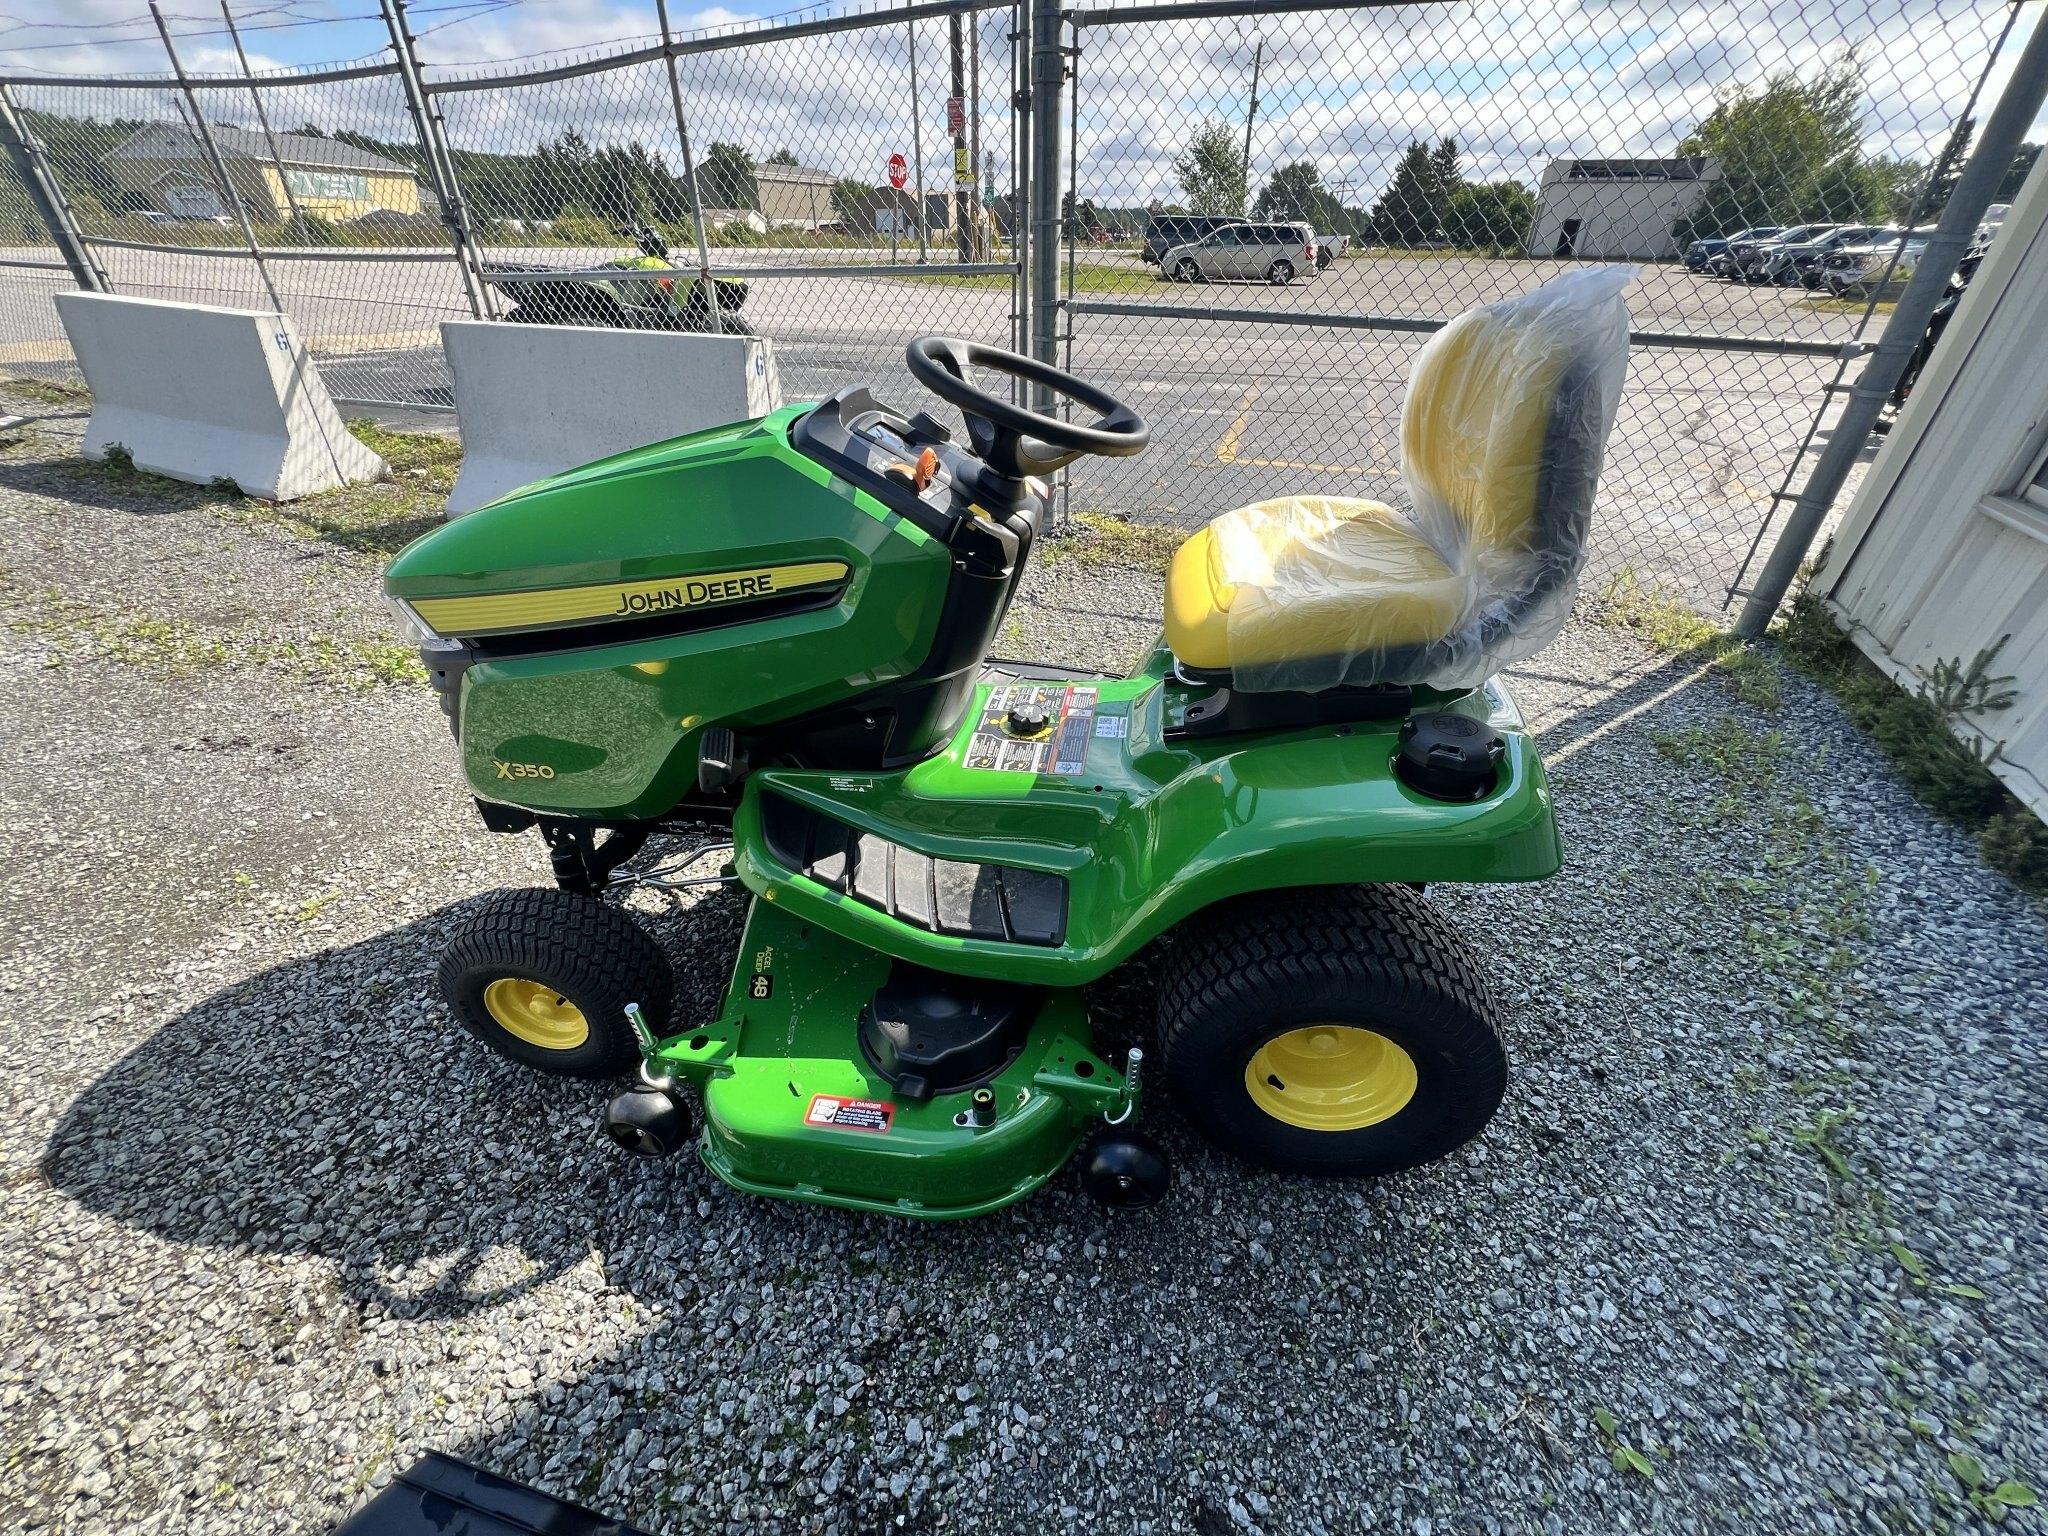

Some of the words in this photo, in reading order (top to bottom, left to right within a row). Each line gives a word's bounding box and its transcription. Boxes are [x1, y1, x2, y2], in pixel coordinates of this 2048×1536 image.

[889, 162, 907, 180] STOP
[616, 589, 684, 614] JOHN
[686, 574, 774, 602] DEERE
[492, 760, 555, 780] X350
[755, 952, 764, 972] DEEP
[764, 946, 773, 970] ACCEL
[754, 976, 768, 997] 48
